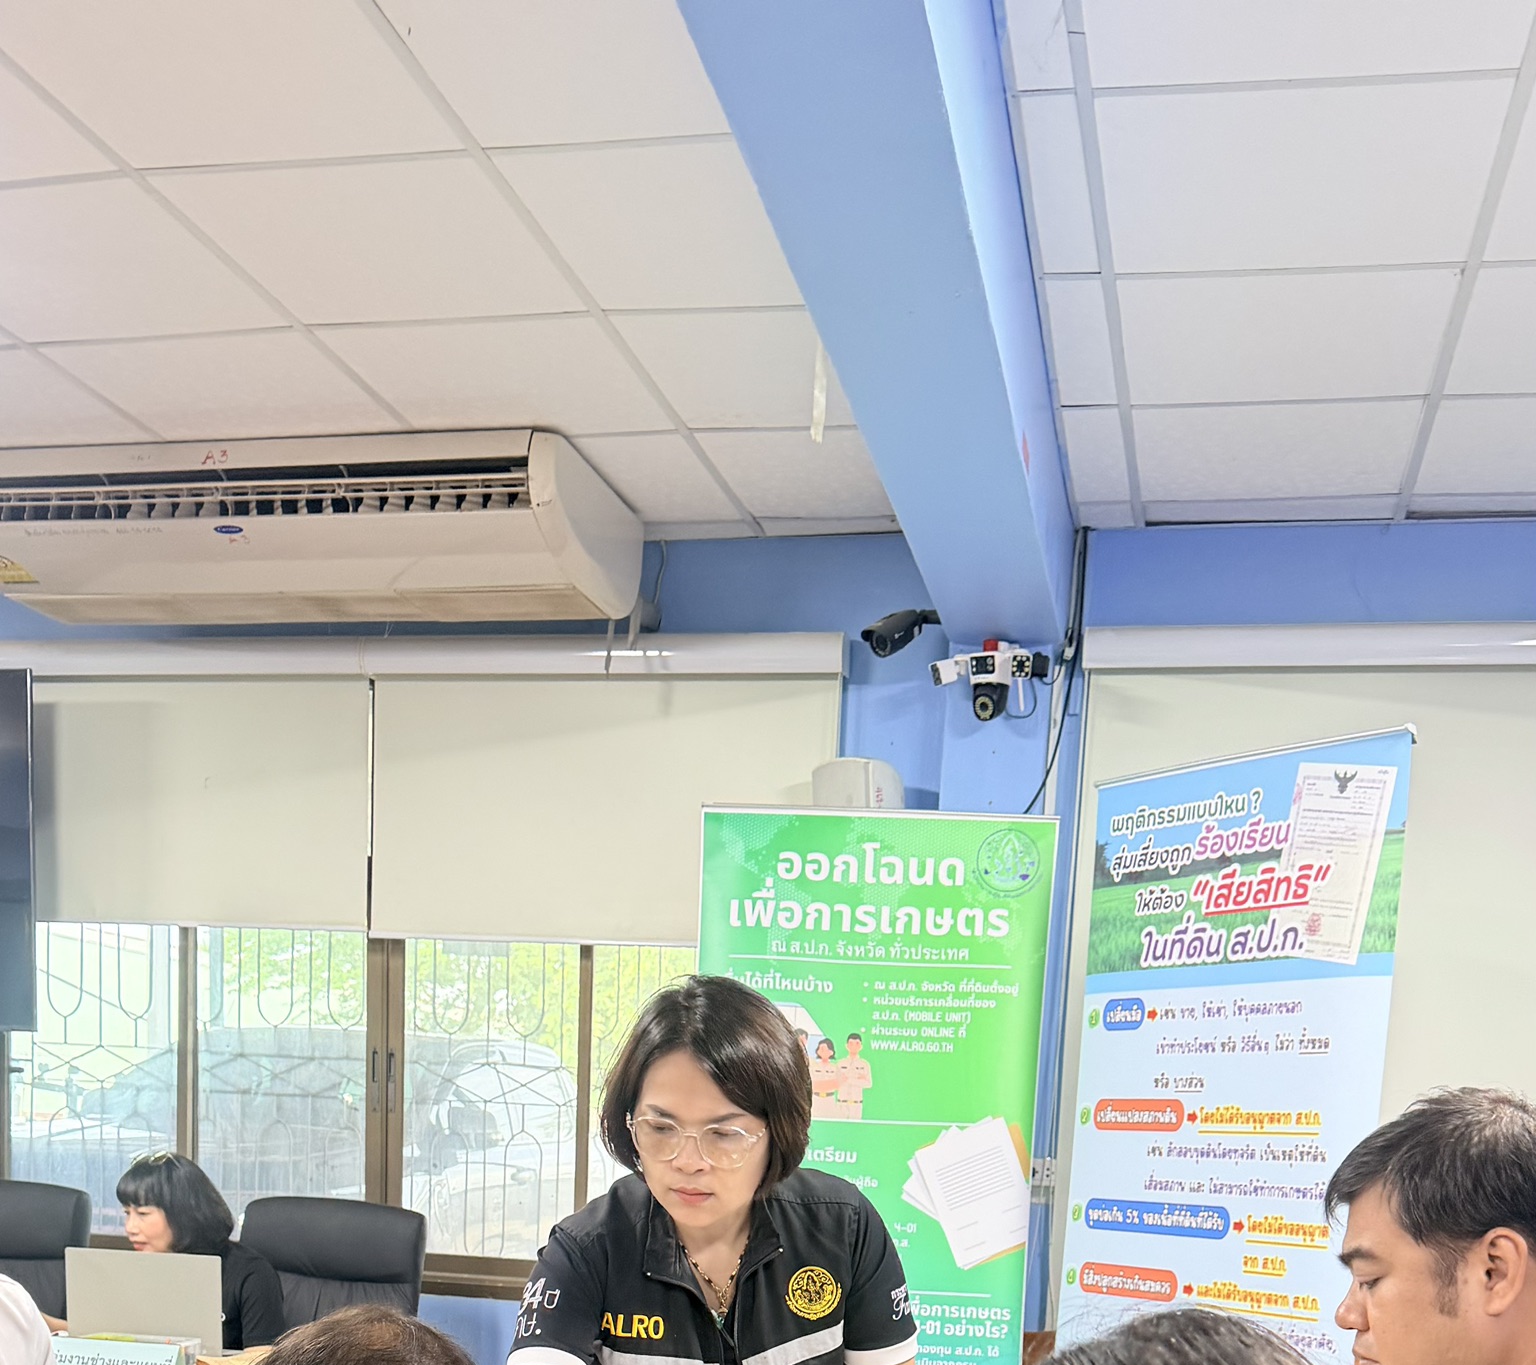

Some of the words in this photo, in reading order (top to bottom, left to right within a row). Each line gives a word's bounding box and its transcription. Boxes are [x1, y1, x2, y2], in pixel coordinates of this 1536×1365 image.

[1251, 790, 1262, 811] ?
[1112, 837, 1193, 880] สุ่มเสี่ยงถูก
[1195, 817, 1292, 858] ร้องเรียน
[777, 842, 966, 887] ออกโฉนด
[729, 877, 1010, 938] เพื่อการเกษตร
[1135, 887, 1186, 916] ให้ต้อง
[1141, 912, 1222, 966] ในที่ดิน
[1230, 917, 1304, 957] ส.ป.ก.
[771, 939, 787, 953] ณ
[791, 939, 833, 957] ส.ป.ก.
[836, 940, 886, 960] จังหวัด
[889, 941, 970, 962] ทั่วประเทศ
[904, 1010, 943, 1023] (MOBILE
[945, 1011, 972, 1024] UNIT)
[921, 1026, 955, 1038] ONLINE
[870, 1040, 954, 1053] WWW.ALRO.GO.TH
[1126, 1208, 1140, 1225] 5%
[601, 1311, 665, 1340] ALRO
[944, 1319, 1009, 1339] อย่างไร?
[987, 1346, 1000, 1357] ได้
